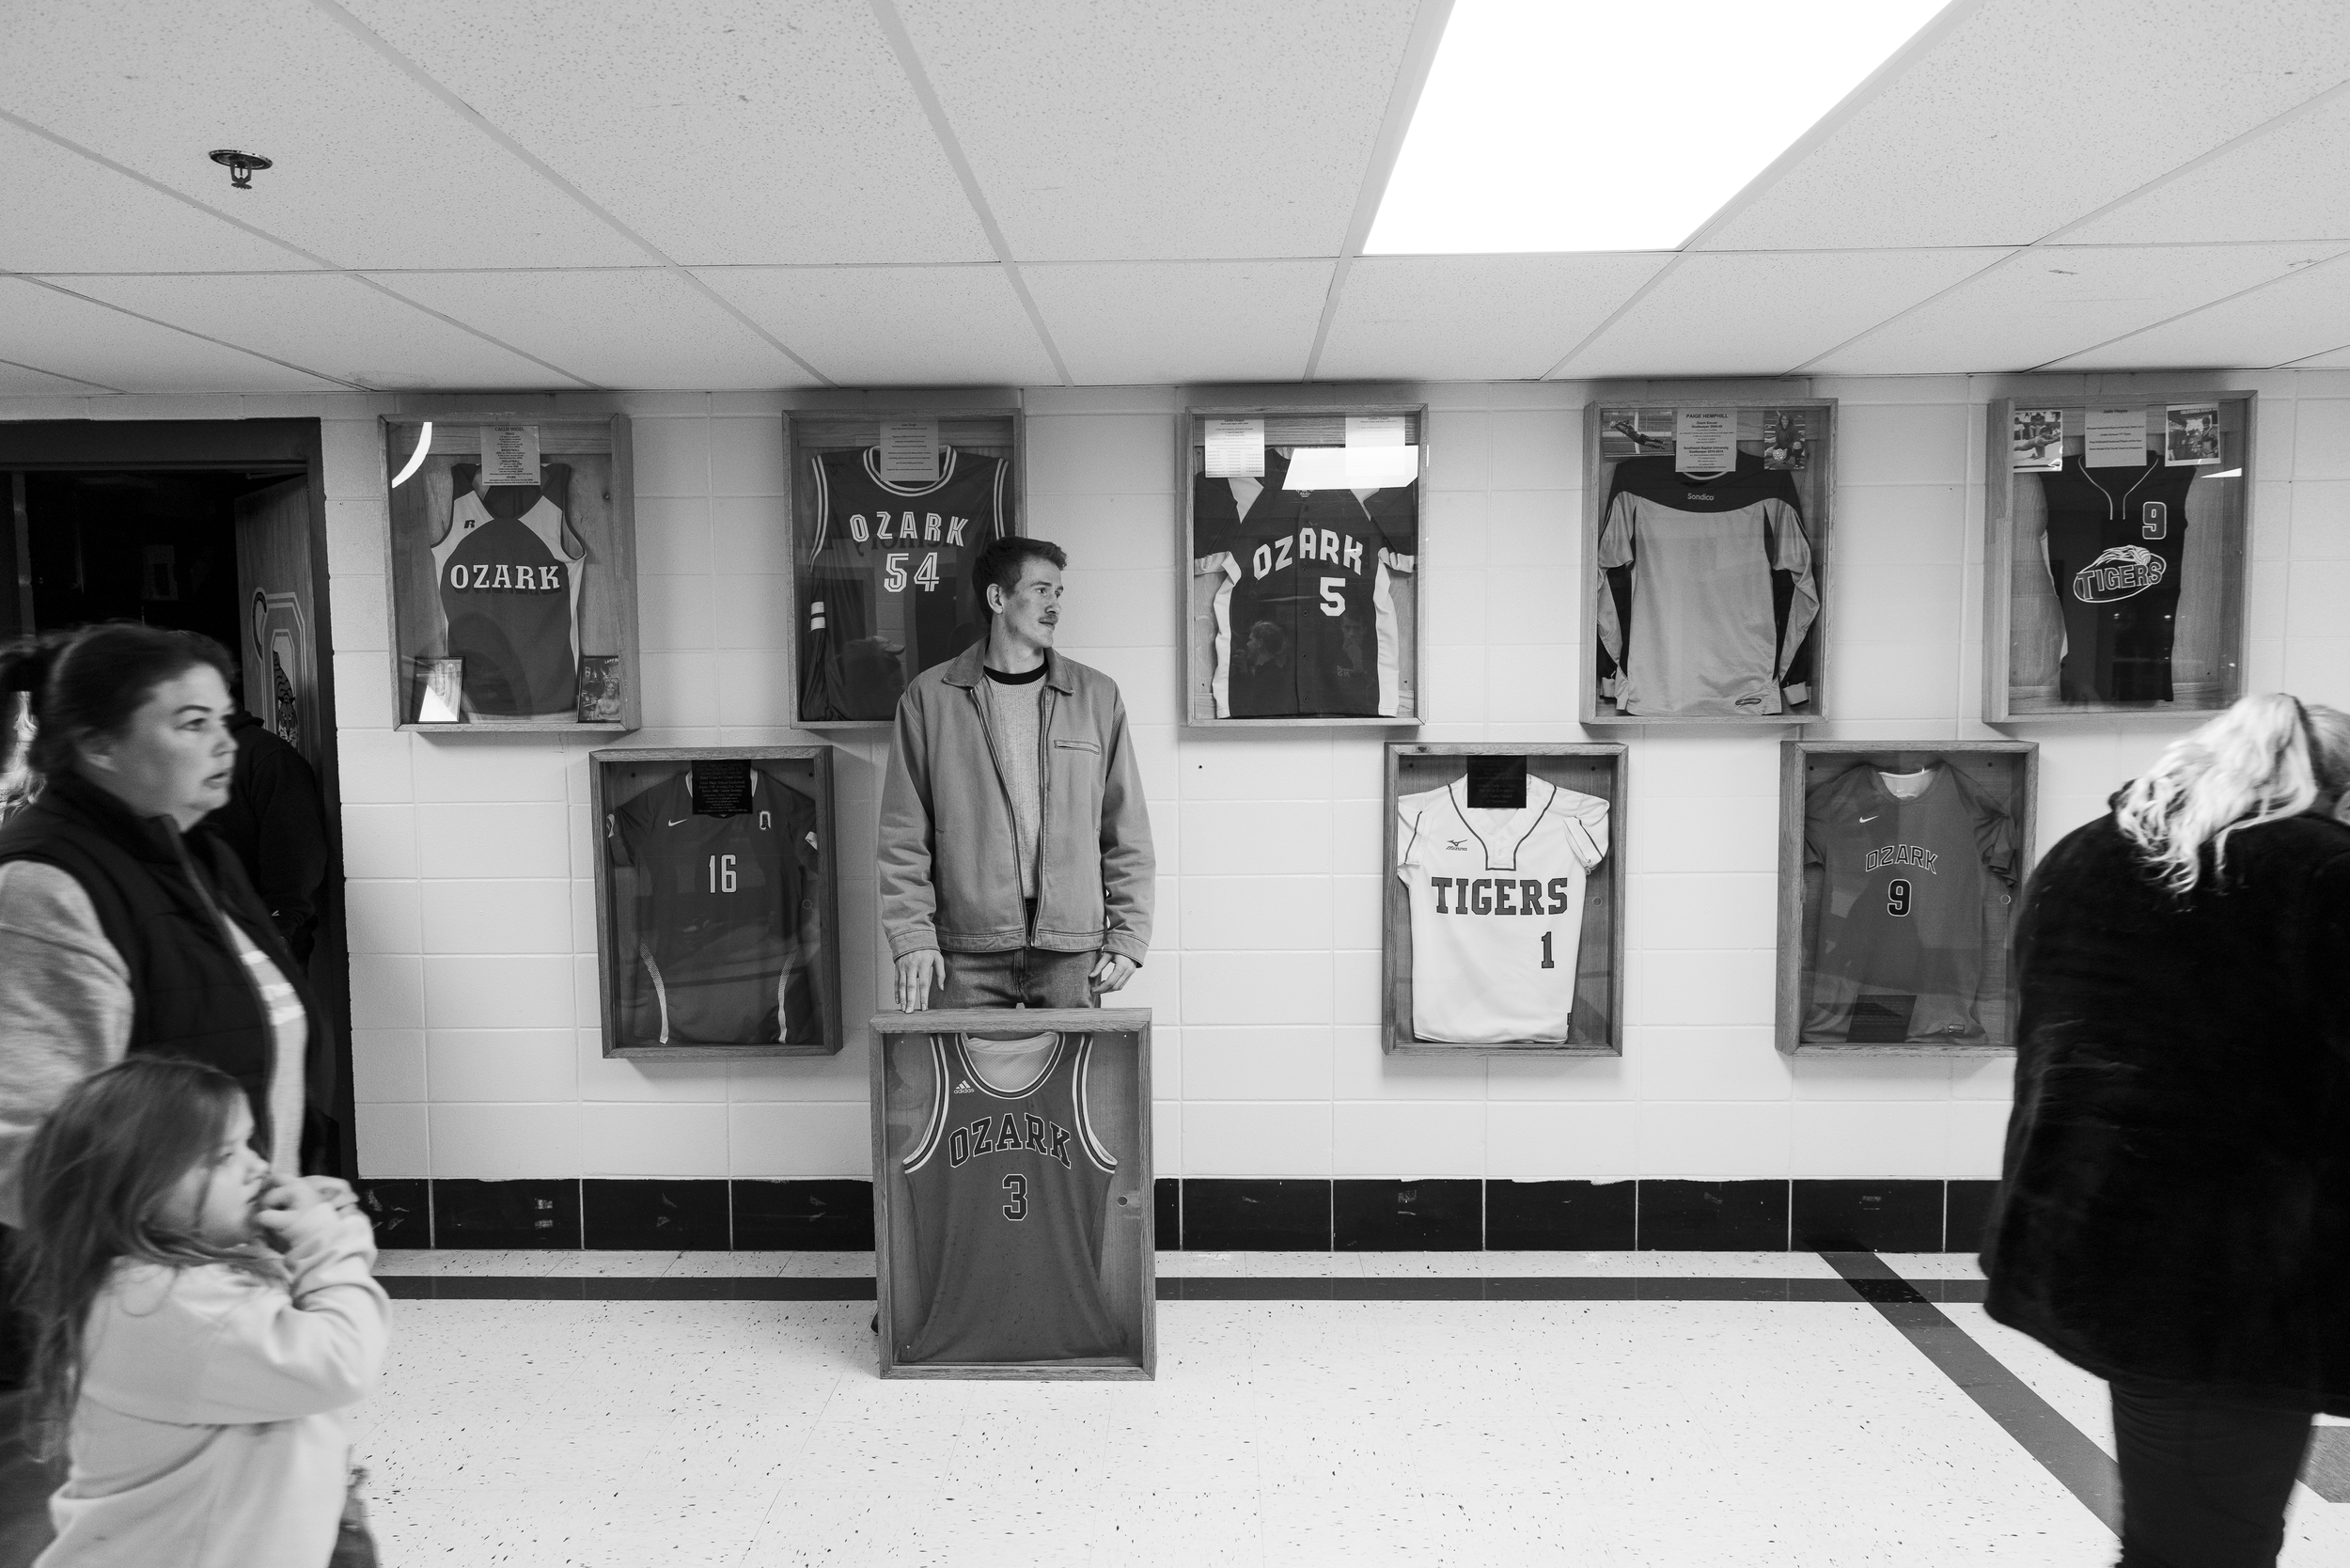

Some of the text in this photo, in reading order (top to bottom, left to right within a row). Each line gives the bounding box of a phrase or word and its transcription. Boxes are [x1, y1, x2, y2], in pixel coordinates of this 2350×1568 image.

[1686, 492, 1714, 501] Sondico
[849, 510, 969, 547] OZARK
[2142, 501, 2167, 540] 9
[884, 552, 940, 592] 54
[1253, 527, 1364, 581] OZARK
[449, 564, 561, 590] OZARK
[1320, 576, 1346, 617] 5
[2076, 561, 2163, 601] TIGERS
[708, 854, 737, 894] 16
[1866, 844, 1938, 874] OZARK
[1432, 877, 1568, 916] TIGERS
[1888, 878, 1912, 917] 9
[1541, 931, 1555, 968] 1
[948, 1112, 1071, 1169] OZARK
[1002, 1173, 1028, 1221] 3
